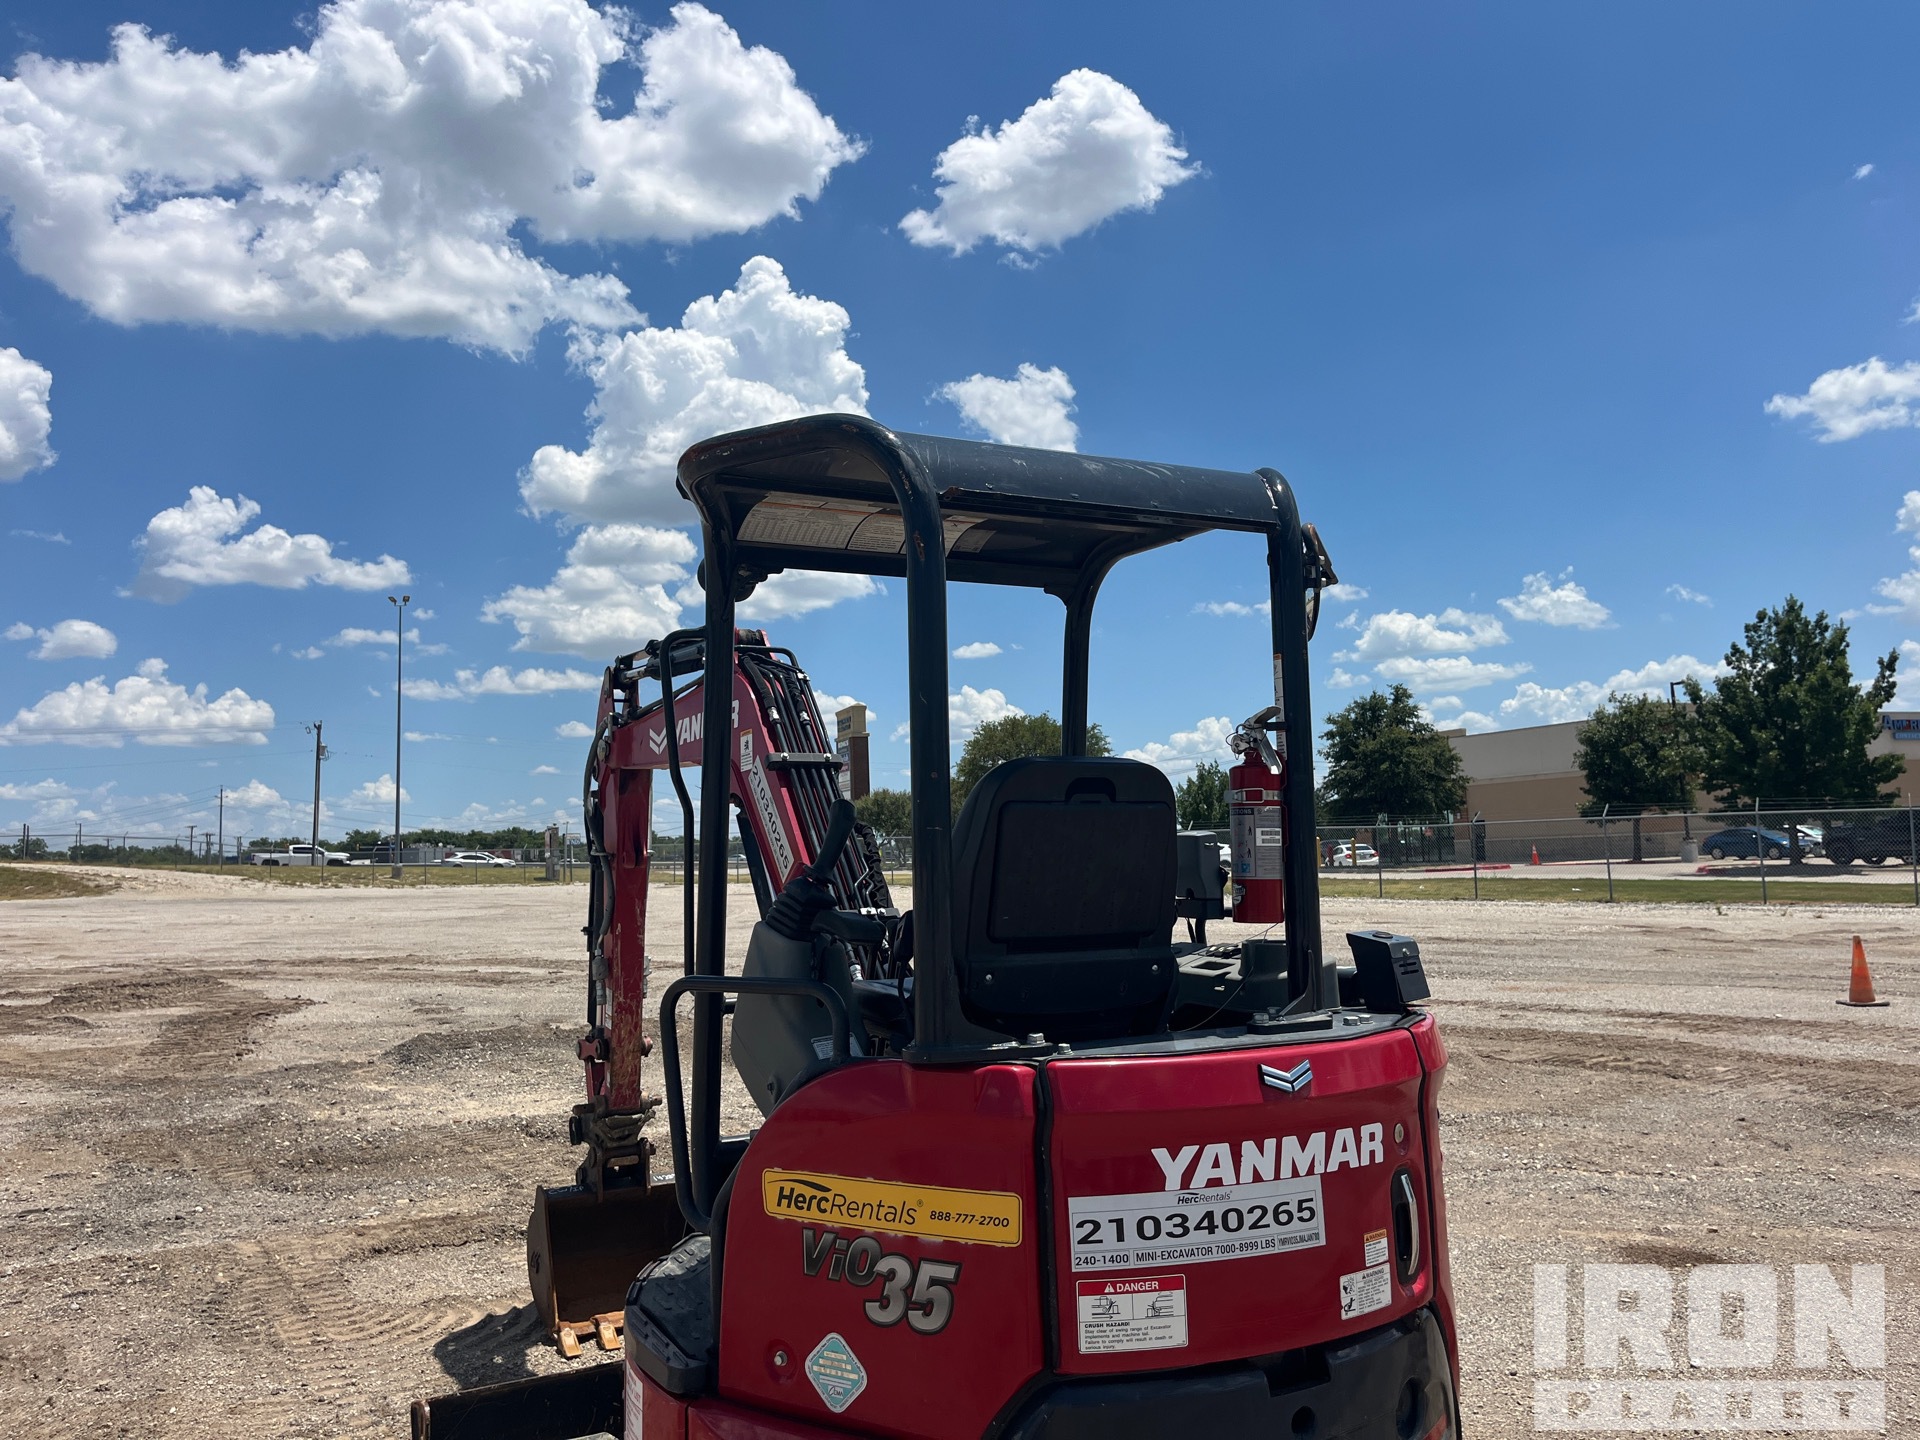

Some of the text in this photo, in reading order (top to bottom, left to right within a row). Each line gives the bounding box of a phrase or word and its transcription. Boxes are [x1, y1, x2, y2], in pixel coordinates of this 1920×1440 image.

[676, 700, 739, 745] YANR
[1151, 1122, 1384, 1191] YANMAR
[929, 1210, 1010, 1228] 888-777-2700
[1075, 1197, 1316, 1245] 210340265
[1075, 1254, 1129, 1266] 240-1400
[1136, 1246, 1213, 1262] MINI-EXCAVATOR
[1215, 1240, 1259, 1255] 7000-8999
[1261, 1238, 1276, 1249] LBS
[1117, 1281, 1159, 1292] DANGER
